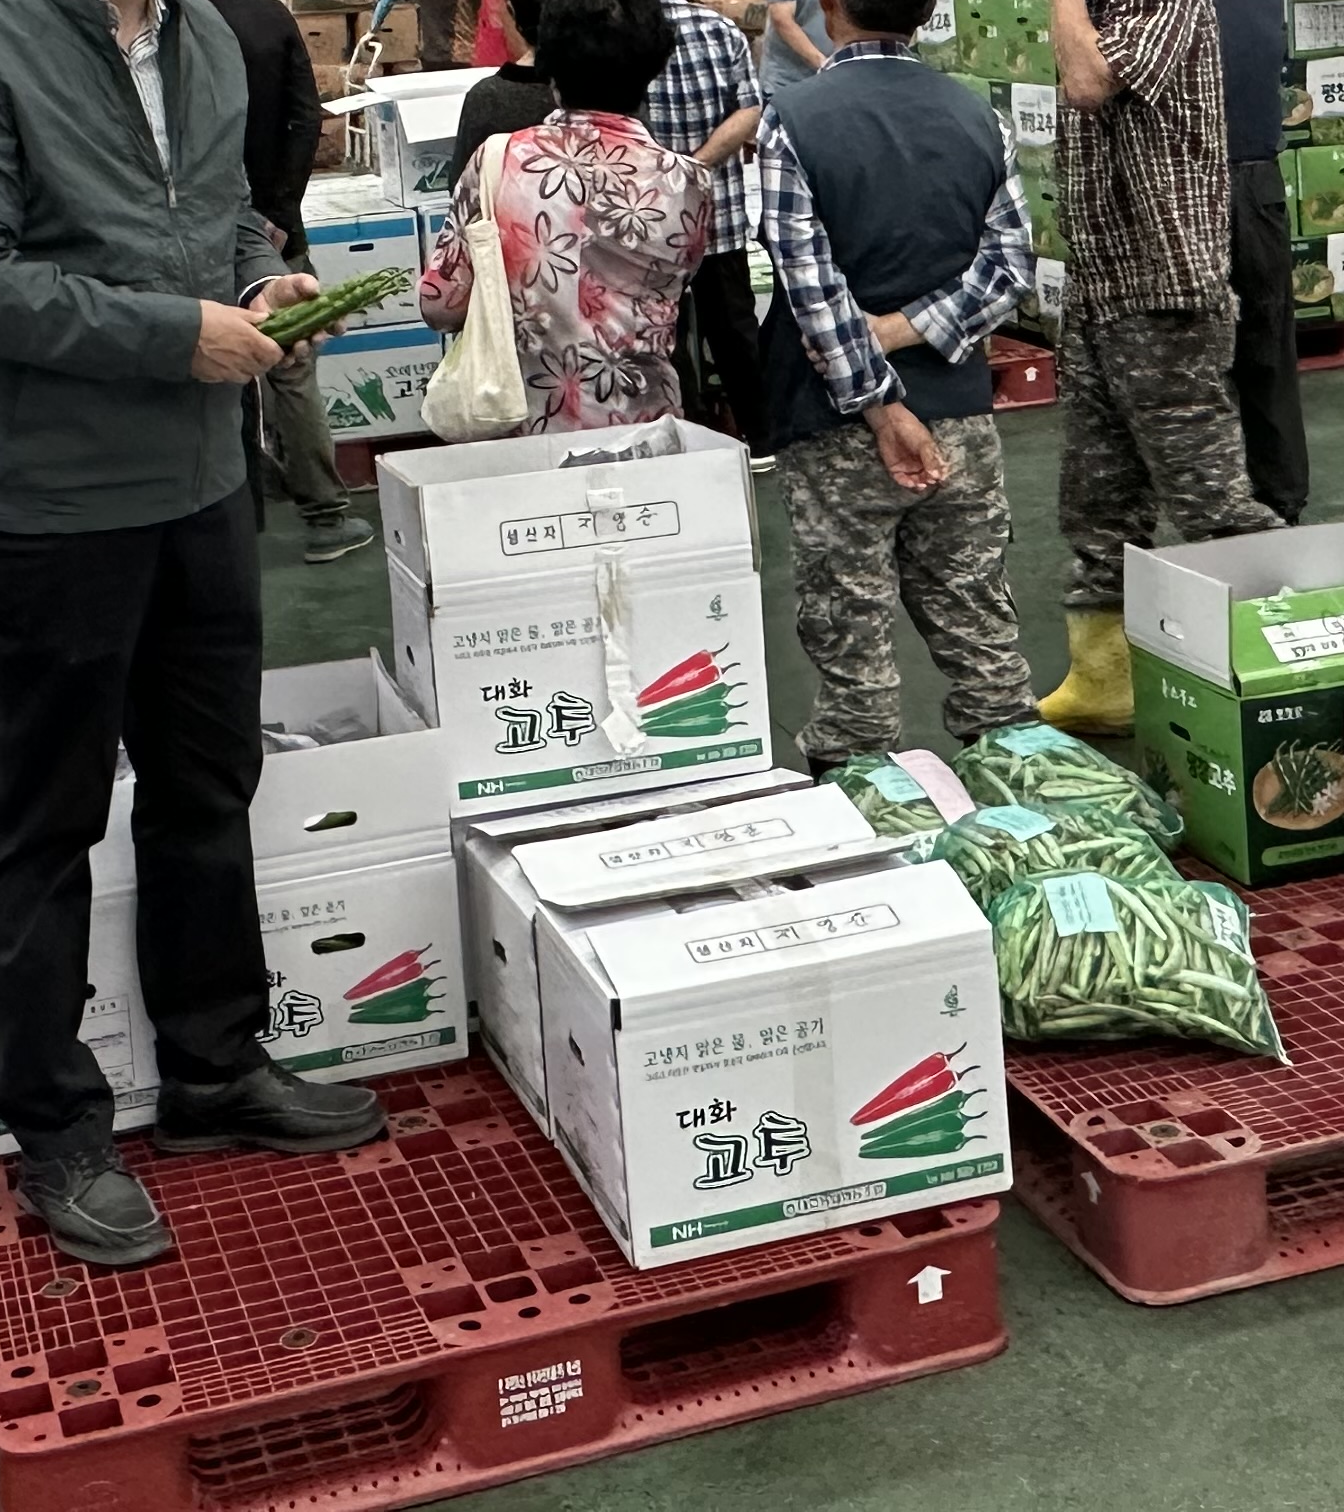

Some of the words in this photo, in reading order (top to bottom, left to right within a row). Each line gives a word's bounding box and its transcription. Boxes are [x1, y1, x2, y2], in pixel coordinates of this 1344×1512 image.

[479, 677, 533, 702] 대화
[477, 779, 504, 795] NH
[675, 1098, 737, 1130] 대화
[671, 1221, 703, 1240] NH
